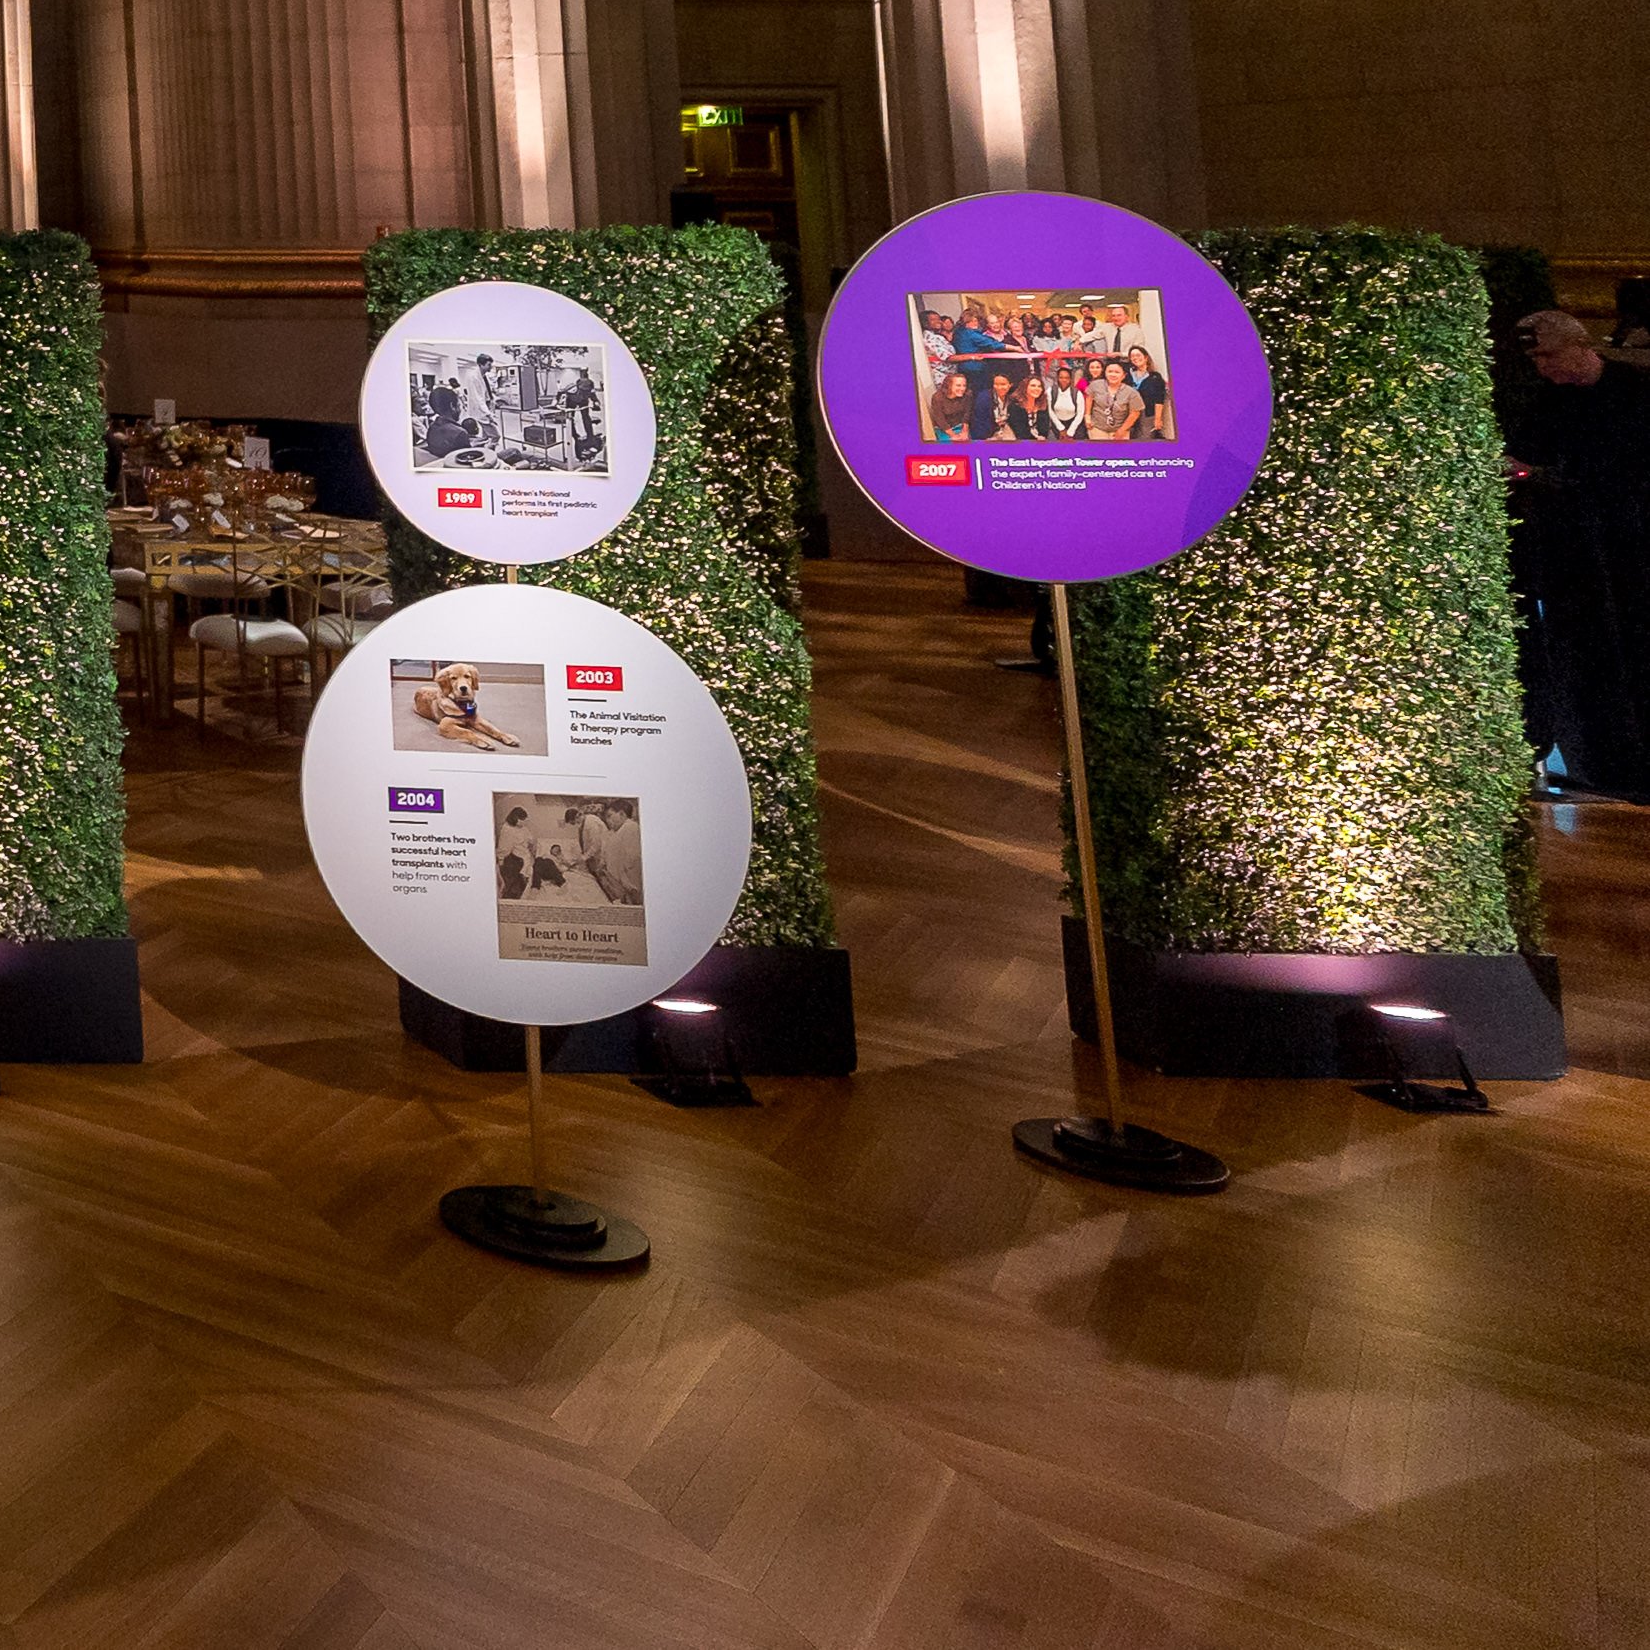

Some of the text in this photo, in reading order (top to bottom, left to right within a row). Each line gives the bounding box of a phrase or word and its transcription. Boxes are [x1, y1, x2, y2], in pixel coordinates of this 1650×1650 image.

[702, 106, 738, 124] EXIT
[989, 458, 1008, 466] The
[1008, 458, 1030, 466] East
[1030, 458, 1074, 468] Inpatient
[1074, 458, 1105, 466] Tower
[1138, 458, 1194, 468] enhancing
[919, 464, 956, 476] 2007
[992, 480, 1086, 490] Children's National
[445, 492, 475, 504] 1989
[576, 670, 613, 684] 2003
[570, 710, 666, 722] The Animal Visitation
[580, 723, 618, 735] Therapy
[620, 727, 662, 736] program
[570, 736, 612, 746] launches
[398, 792, 435, 806] 2004
[391, 832, 476, 844] Two brothers have
[391, 846, 466, 856] successful heart
[392, 858, 445, 869] transplants
[525, 927, 619, 943] Heart to Heart
